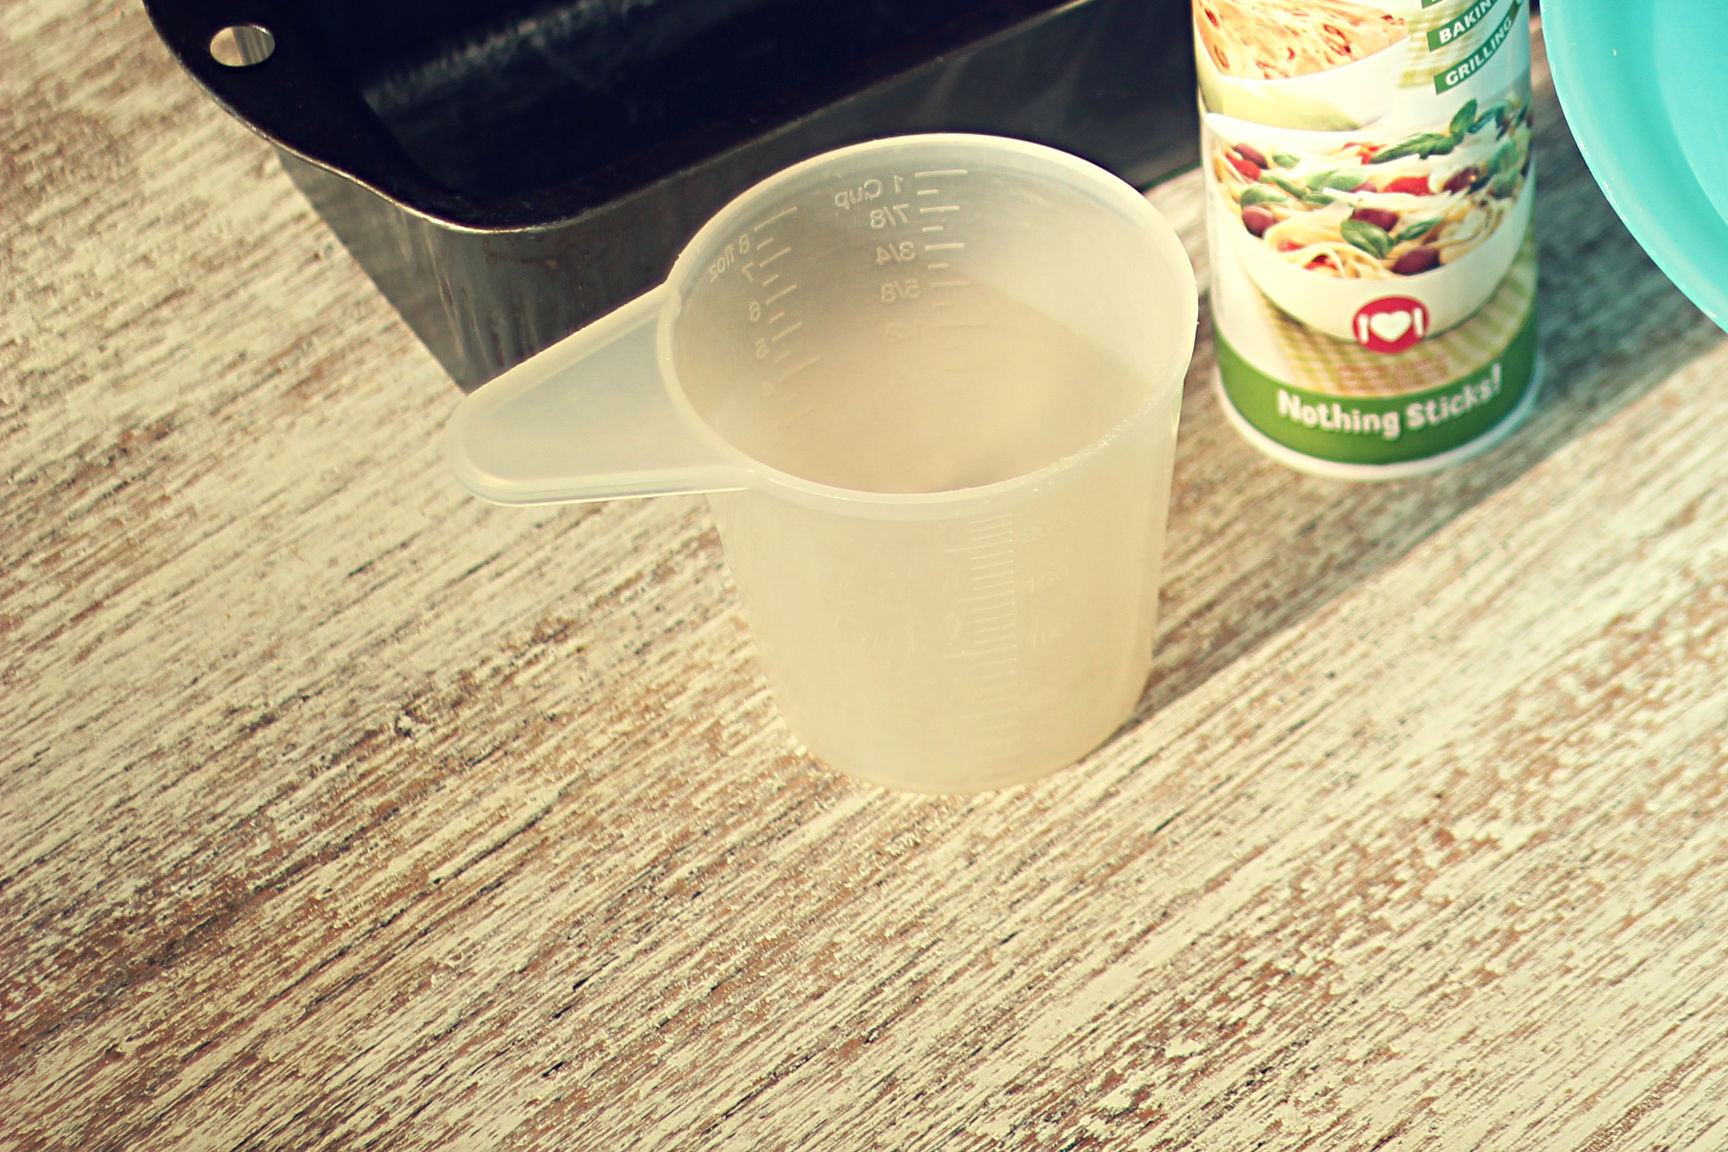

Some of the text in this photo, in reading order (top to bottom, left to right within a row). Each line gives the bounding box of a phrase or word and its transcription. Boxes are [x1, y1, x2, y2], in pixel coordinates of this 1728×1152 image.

[1444, 15, 1514, 86] GRILLING
[1276, 389, 1401, 440] Nothing
[1405, 363, 1503, 430] Sticks!
